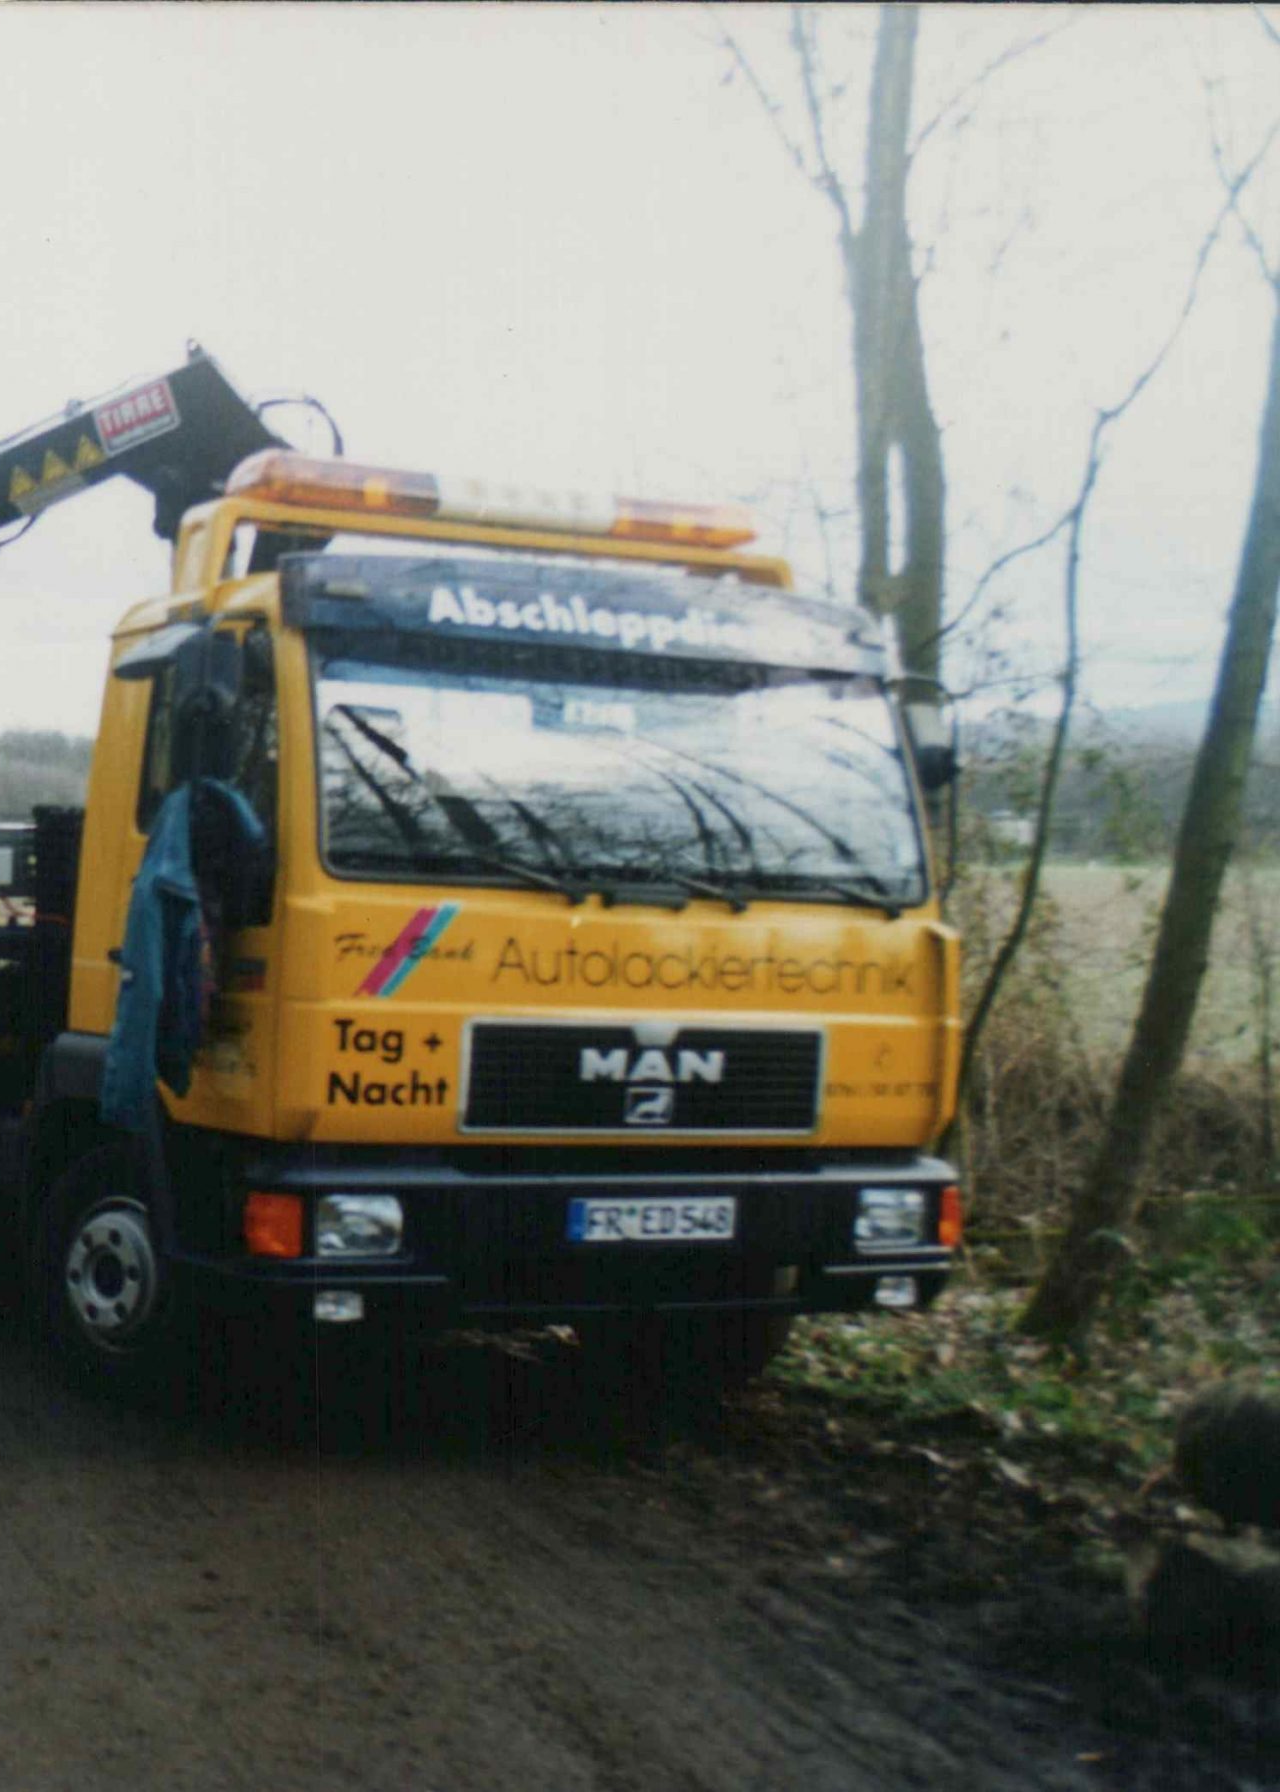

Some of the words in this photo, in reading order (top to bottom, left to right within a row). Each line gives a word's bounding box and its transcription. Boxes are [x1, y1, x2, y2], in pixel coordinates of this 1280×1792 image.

[492, 936, 913, 994] Autolackiertechnik
[333, 1018, 404, 1063] Tag
[423, 1033, 442, 1052] +
[579, 1047, 725, 1083] MAN
[327, 1070, 448, 1105] Nacht
[588, 1205, 623, 1235] FR
